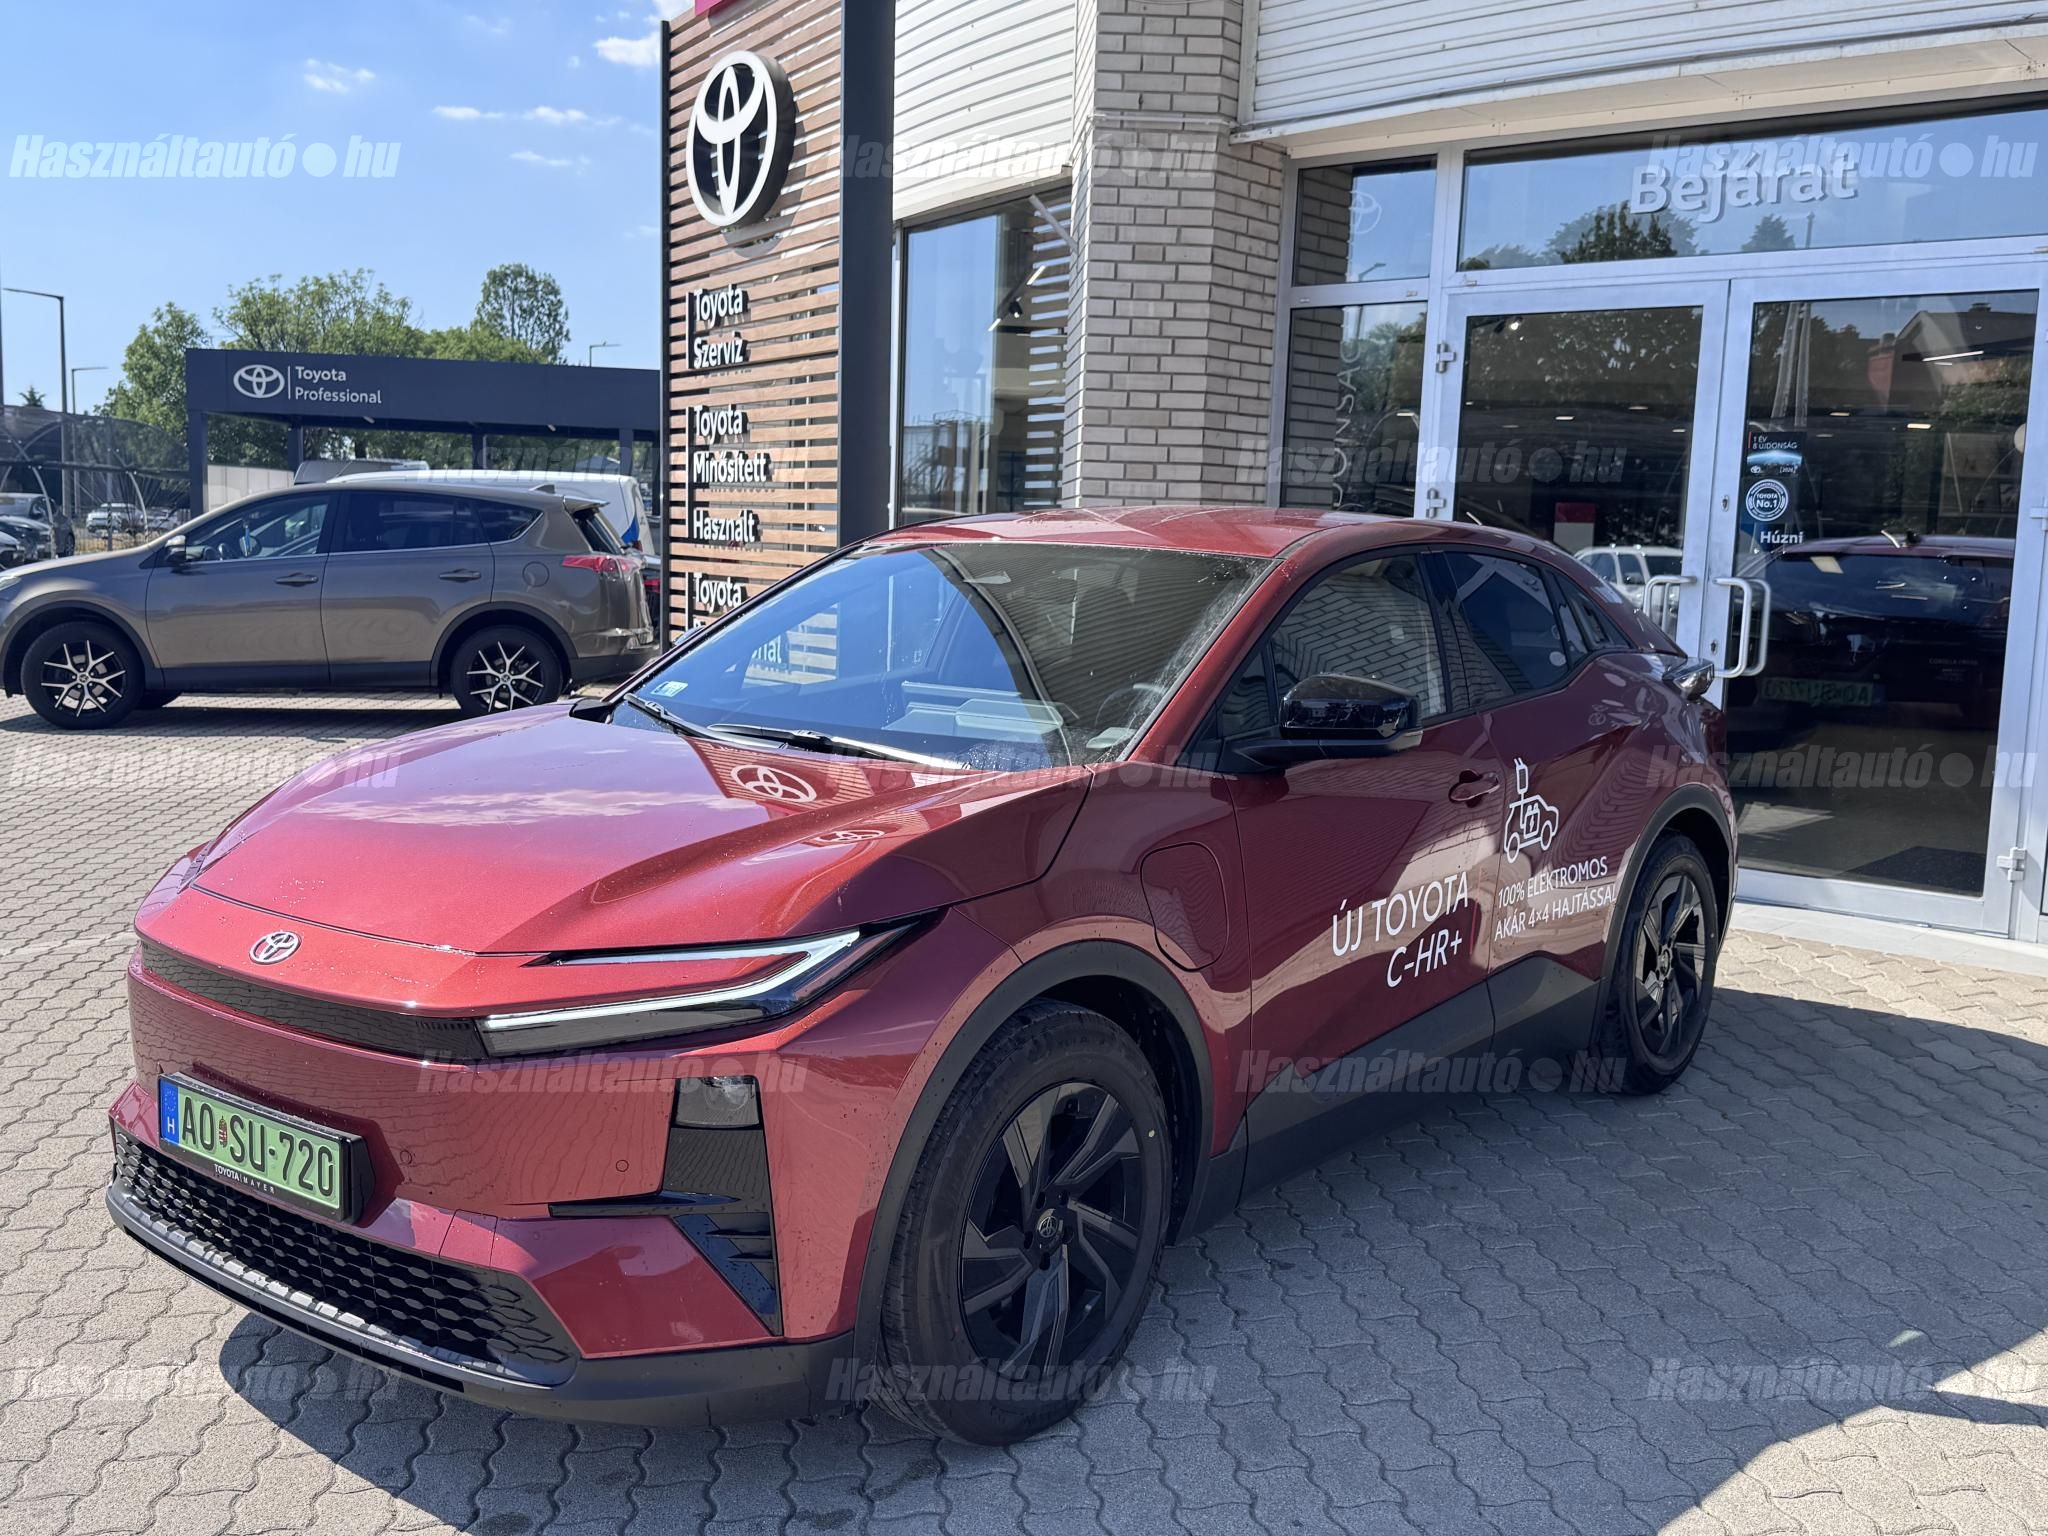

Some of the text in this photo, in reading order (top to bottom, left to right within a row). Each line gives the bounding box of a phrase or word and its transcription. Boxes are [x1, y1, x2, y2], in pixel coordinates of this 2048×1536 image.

[1631, 152, 1859, 222] Bejárat
[693, 283, 743, 328] Toyota
[693, 331, 743, 369] Szerviz
[295, 365, 347, 383] Toyota
[295, 386, 382, 404] Professional
[693, 404, 743, 444] Toyota
[693, 450, 767, 483] Minősített
[1756, 500, 1777, 508] No.1
[693, 507, 755, 543] Használt
[693, 571, 742, 613] Toyota
[1498, 856, 1608, 909] 100% ELEKTROMOS
[1332, 871, 1469, 957] ÚJ TOYOTA
[1494, 908, 1526, 942] AKÁR
[1551, 884, 1617, 922] HAJTÁSSAL
[1386, 928, 1463, 989] C-HR+
[166, 1116, 176, 1136] H
[214, 1163, 240, 1181] TOYOTA
